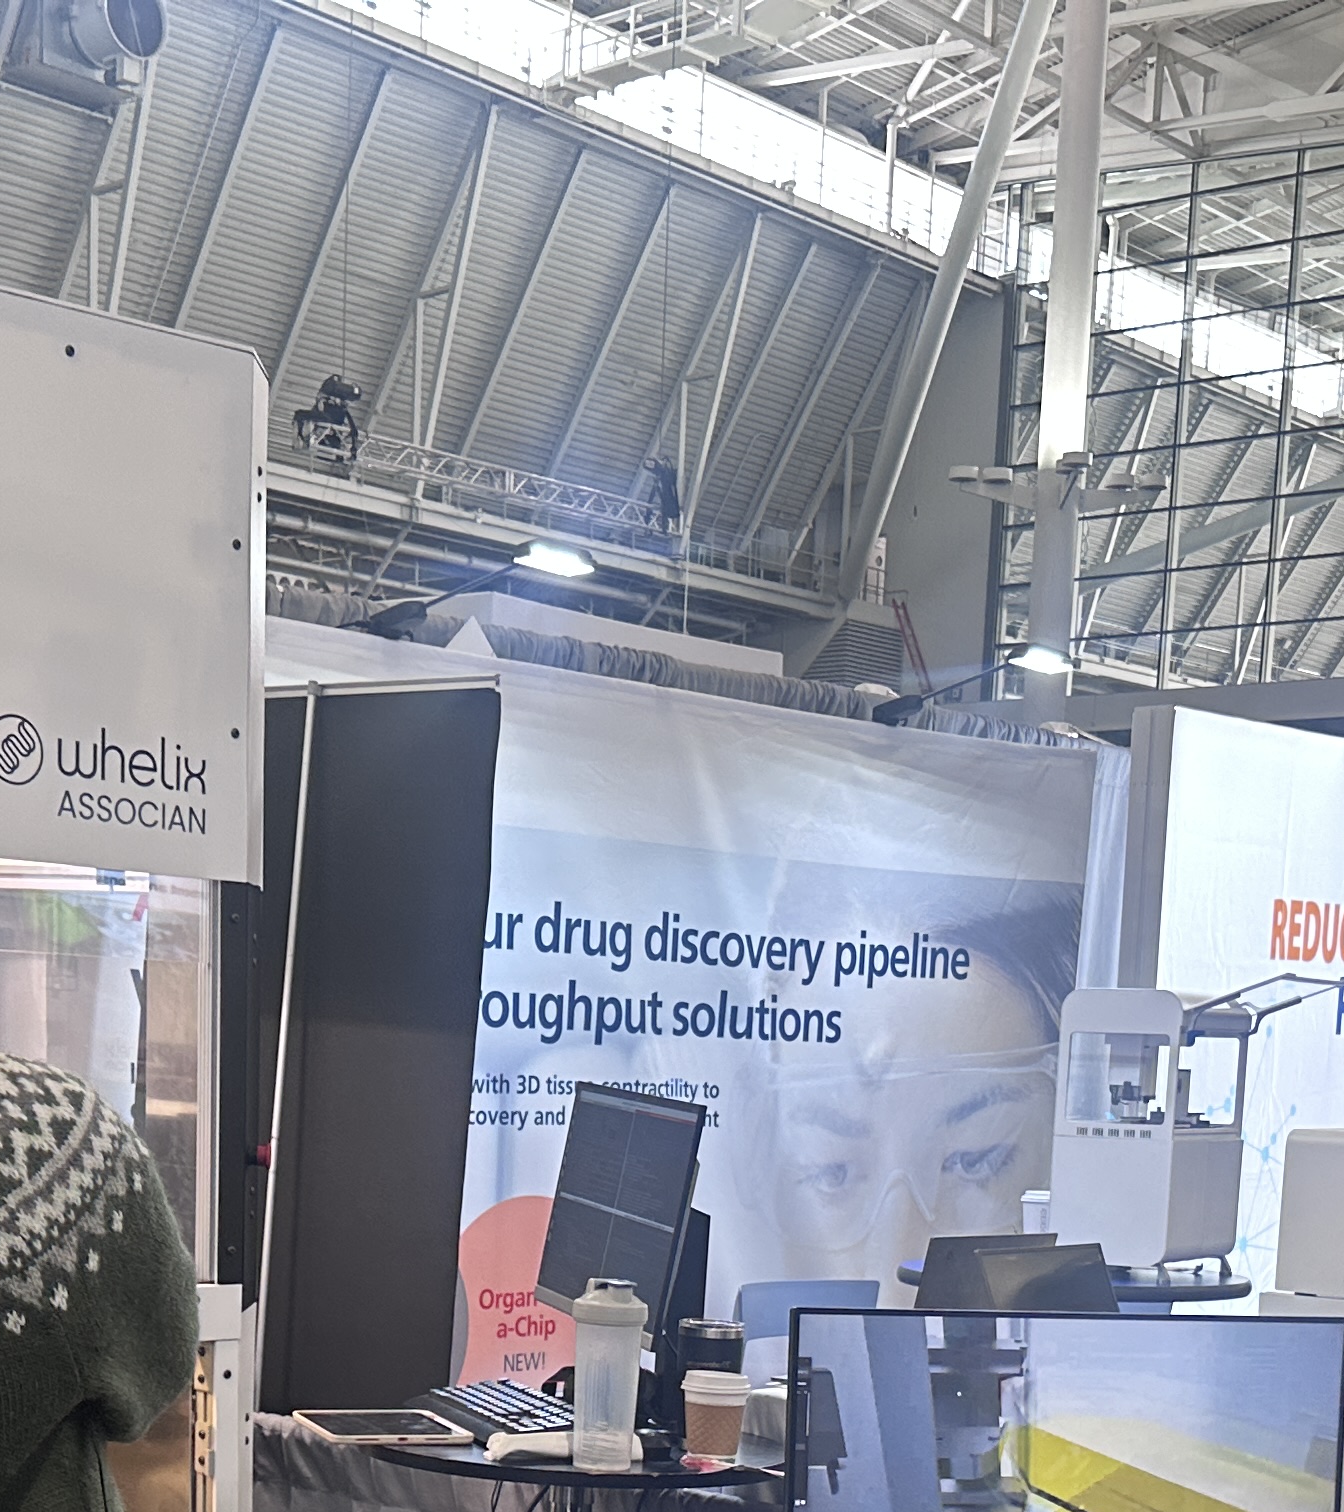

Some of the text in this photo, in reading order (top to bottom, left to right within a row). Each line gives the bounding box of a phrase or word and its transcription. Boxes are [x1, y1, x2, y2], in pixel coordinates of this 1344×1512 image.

[57, 727, 206, 795] whelix
[57, 790, 206, 835] ASSOCIAN
[534, 900, 632, 972] drug
[644, 910, 825, 986] discovery
[834, 930, 970, 989] pipeline
[481, 978, 842, 1046] oughput solutions
[471, 1073, 510, 1096] with
[517, 1074, 540, 1096] 3D
[703, 1082, 720, 1100] to
[534, 1105, 566, 1127] and
[496, 1314, 556, 1341] a-Chip
[503, 1351, 546, 1373] NEW!
